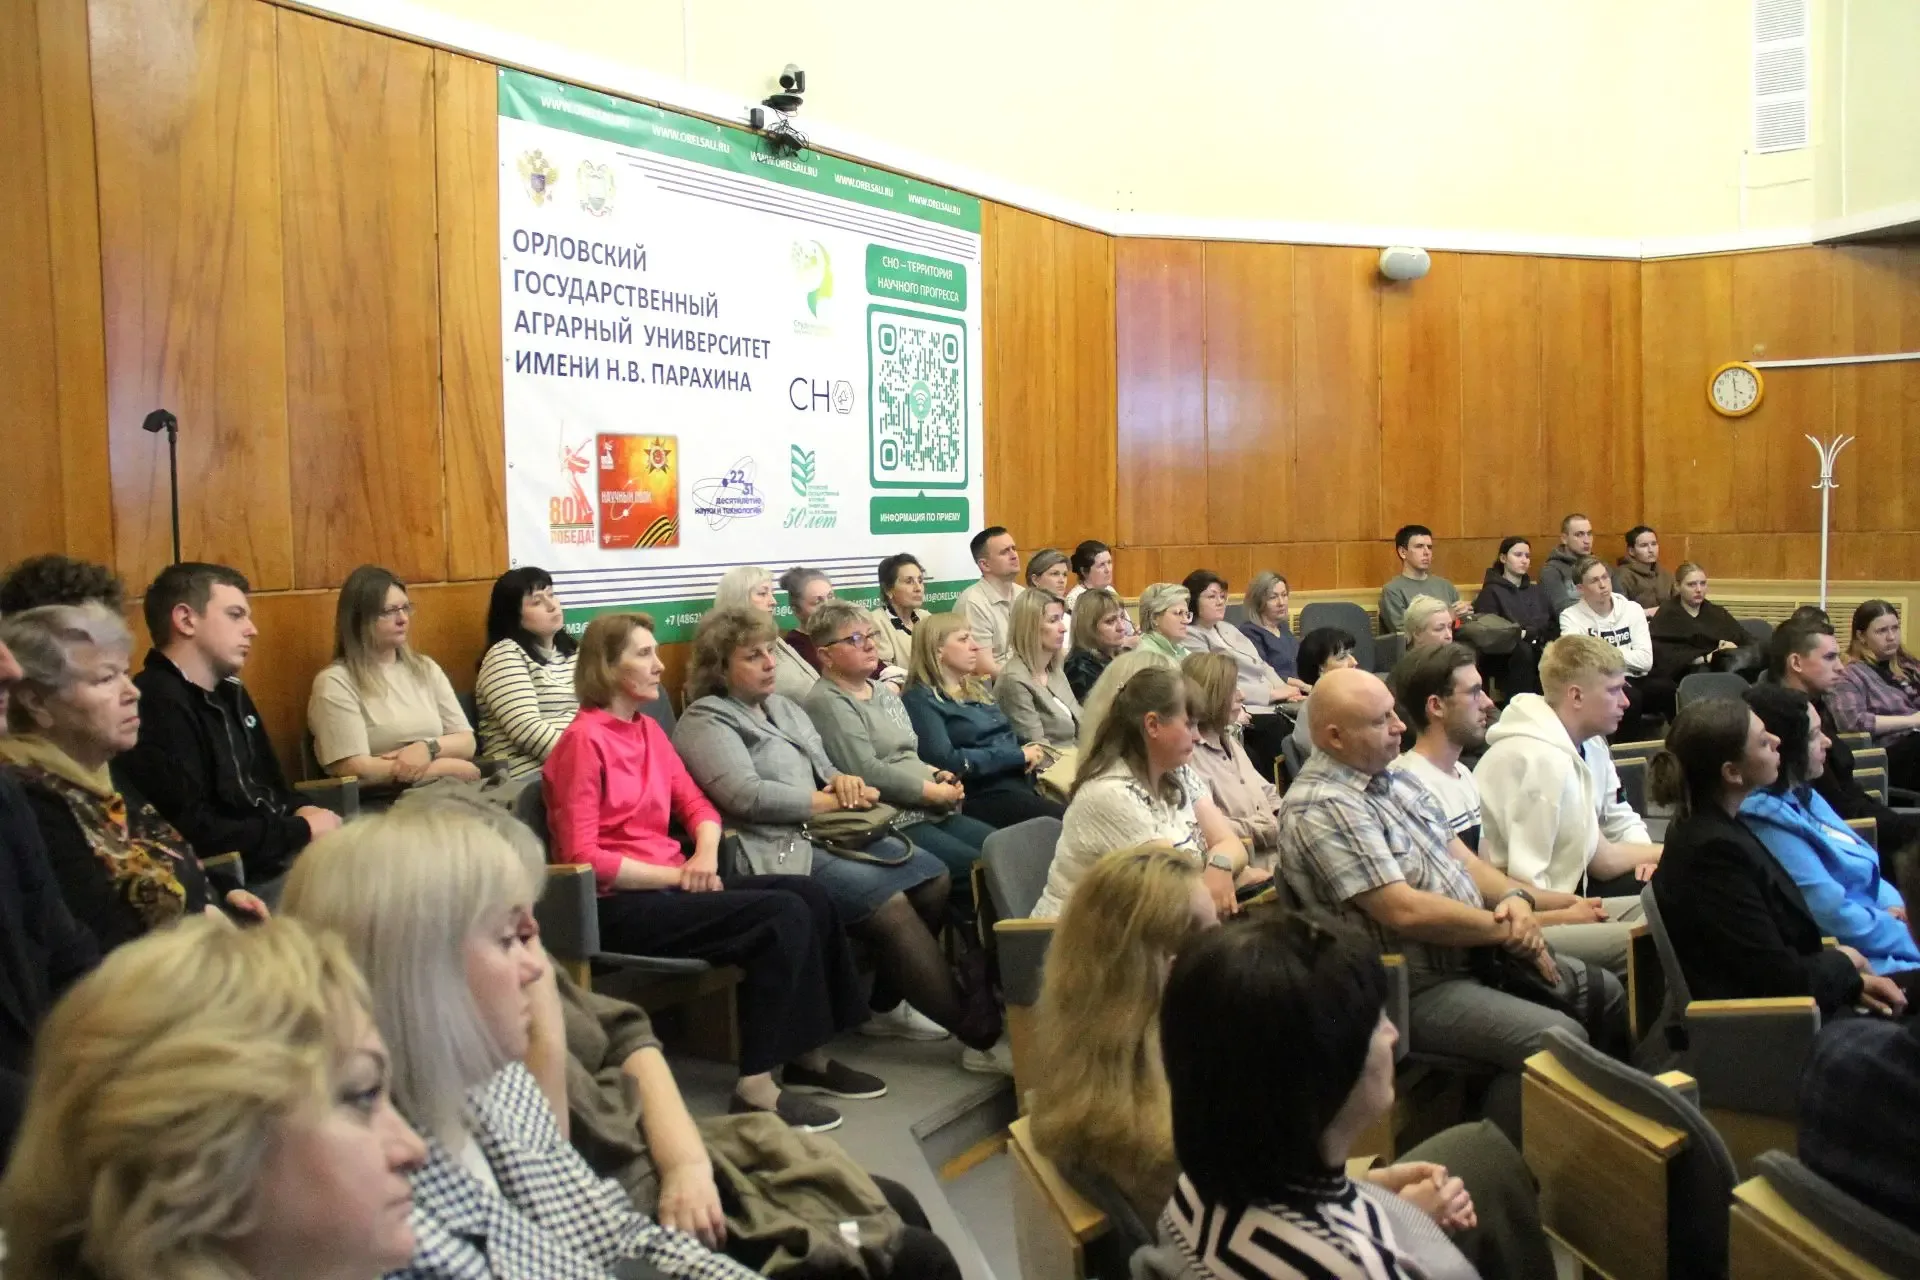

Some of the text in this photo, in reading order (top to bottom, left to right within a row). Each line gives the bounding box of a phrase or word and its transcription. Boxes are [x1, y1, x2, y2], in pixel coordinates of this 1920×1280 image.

[652, 124, 730, 154] WWW.ORELSAU.RU
[834, 173, 894, 198] WWW.ORELSAU.RU
[908, 193, 961, 216] WWW.ORELSAU.RU
[513, 229, 647, 272] ОРЛОВСКИЙ
[882, 256, 899, 269] СНО
[907, 260, 953, 280] ТЕРРИТОРИЯ
[514, 269, 718, 318] ГОСУДАРСТВЕННЫЙ
[878, 276, 960, 302] НАУЧНОГО ПРОГРЕССА
[514, 310, 771, 360] АГРАРНЫЙ УНИВЕРСИТЕТ
[515, 350, 752, 392] ИМЕНИ Н.В. ПАРАХИНА
[730, 470, 745, 483] 22
[880, 512, 960, 523] ИНФОРМАЦИЯ ПО ПРИЕМУ
